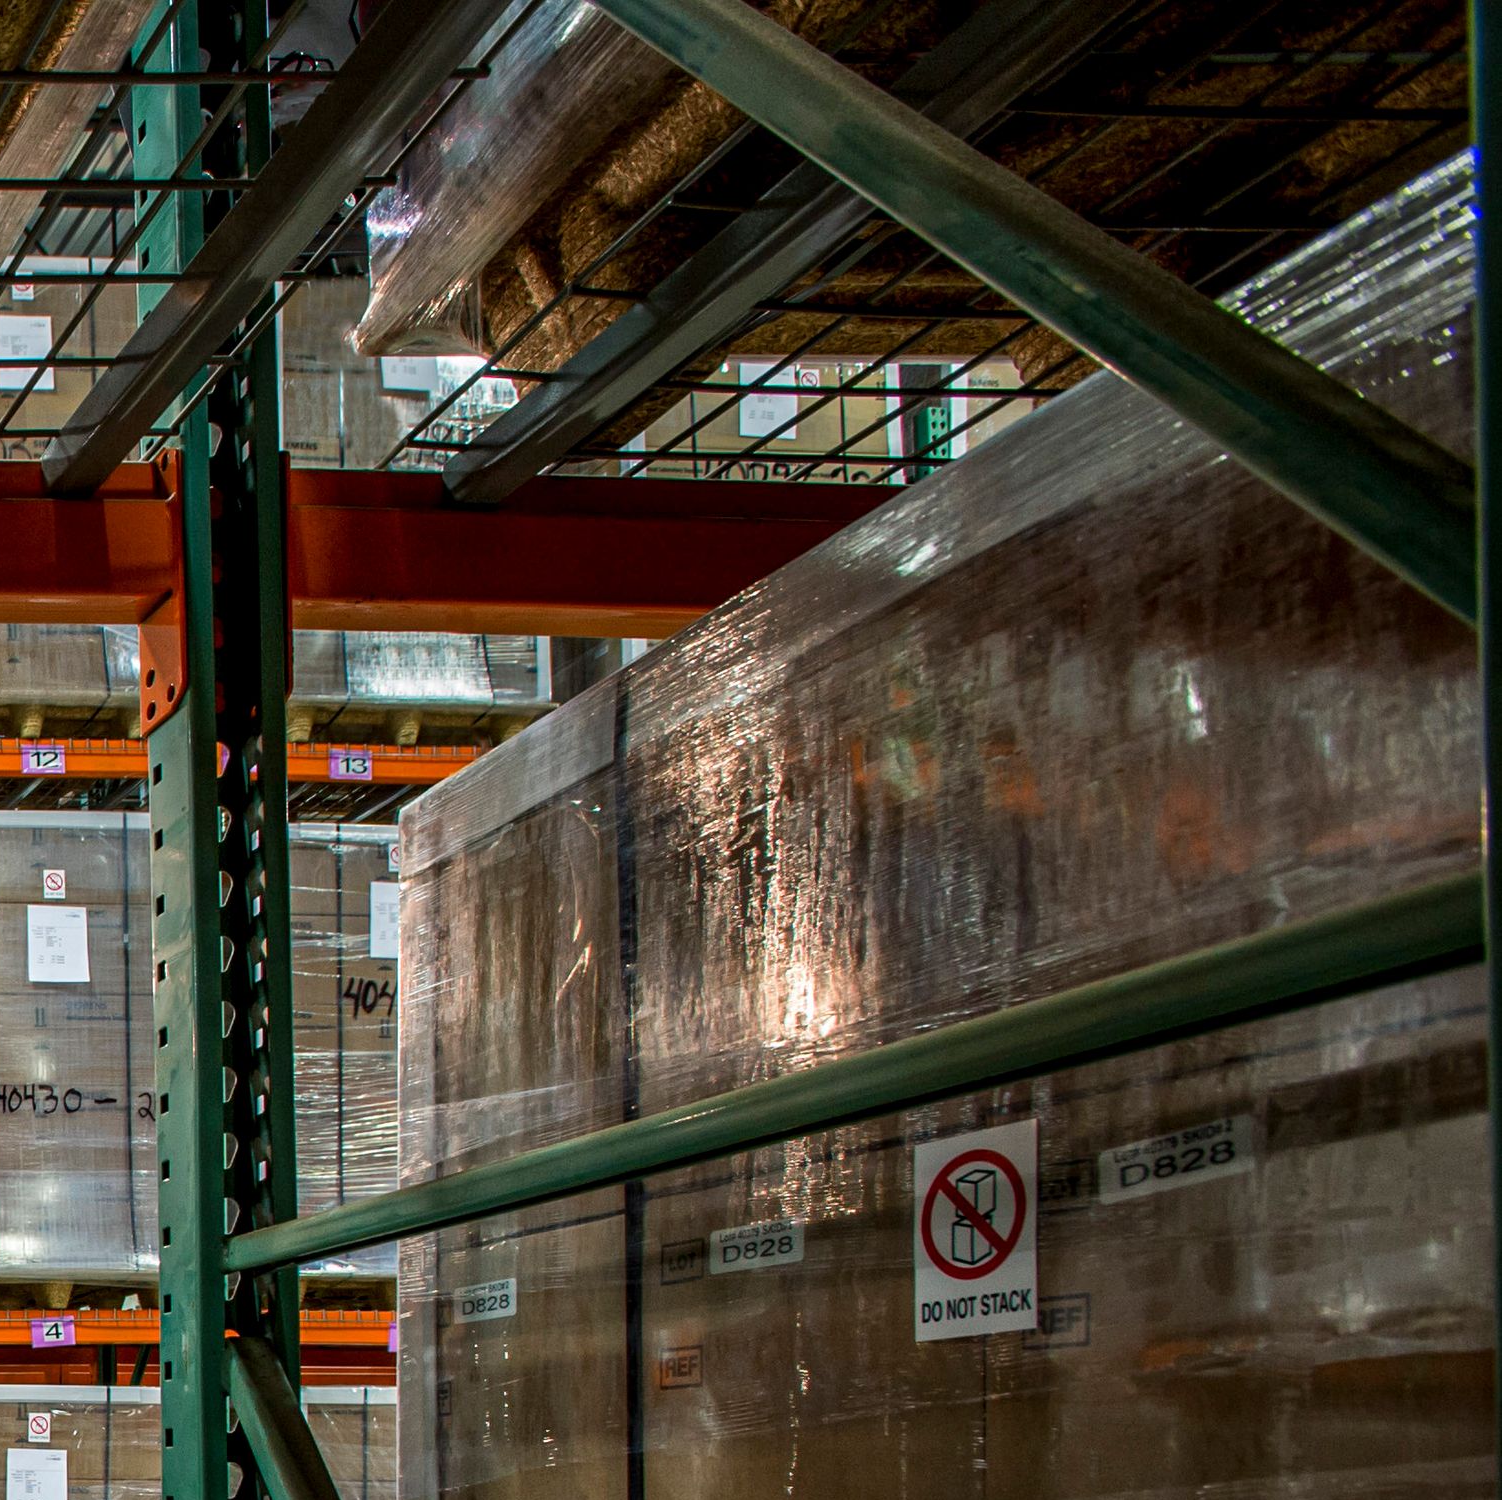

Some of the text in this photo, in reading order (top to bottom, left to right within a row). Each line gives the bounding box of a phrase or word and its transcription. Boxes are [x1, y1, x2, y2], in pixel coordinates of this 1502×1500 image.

[31, 751, 60, 769] 12
[339, 757, 369, 775] 13
[1120, 1140, 1235, 1188] D828
[722, 1236, 794, 1263] D828
[461, 1293, 510, 1316] D828
[921, 1288, 1032, 1323] DO NOT STACK
[45, 1322, 64, 1340] 4
